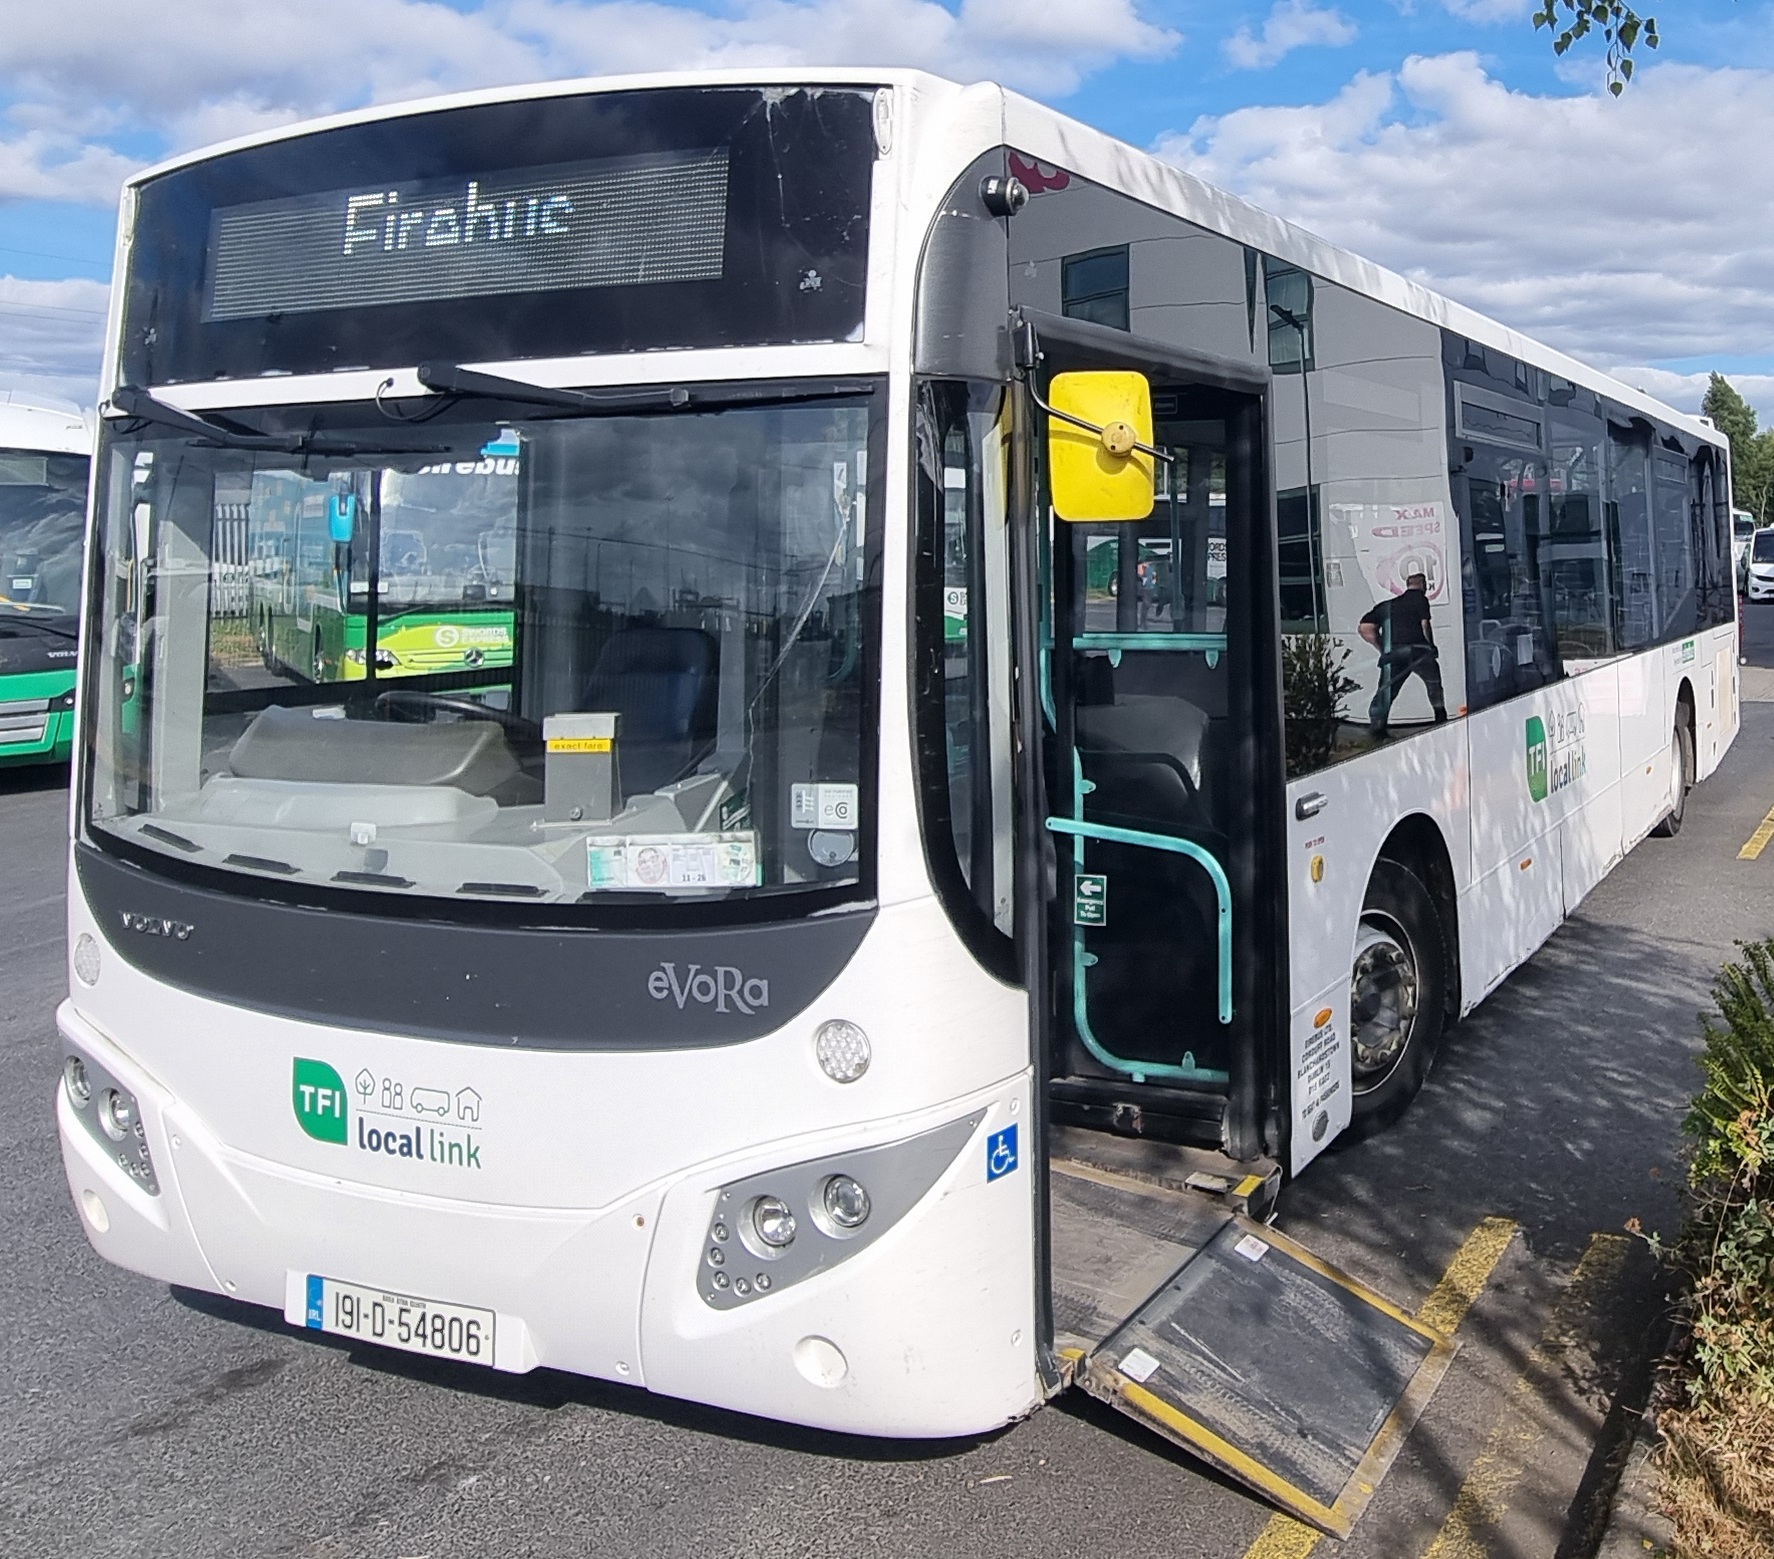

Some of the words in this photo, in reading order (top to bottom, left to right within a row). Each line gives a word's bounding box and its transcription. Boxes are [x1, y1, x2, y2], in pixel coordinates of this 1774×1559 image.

[1529, 741, 1545, 776] TFI
[1550, 750, 1571, 794] local
[119, 911, 194, 940] VOLVO
[300, 1084, 341, 1119] TFI
[358, 1116, 424, 1160] local
[430, 1128, 481, 1170] link
[308, 1308, 321, 1322] IRL
[334, 1291, 482, 1357] 191-D-54806
